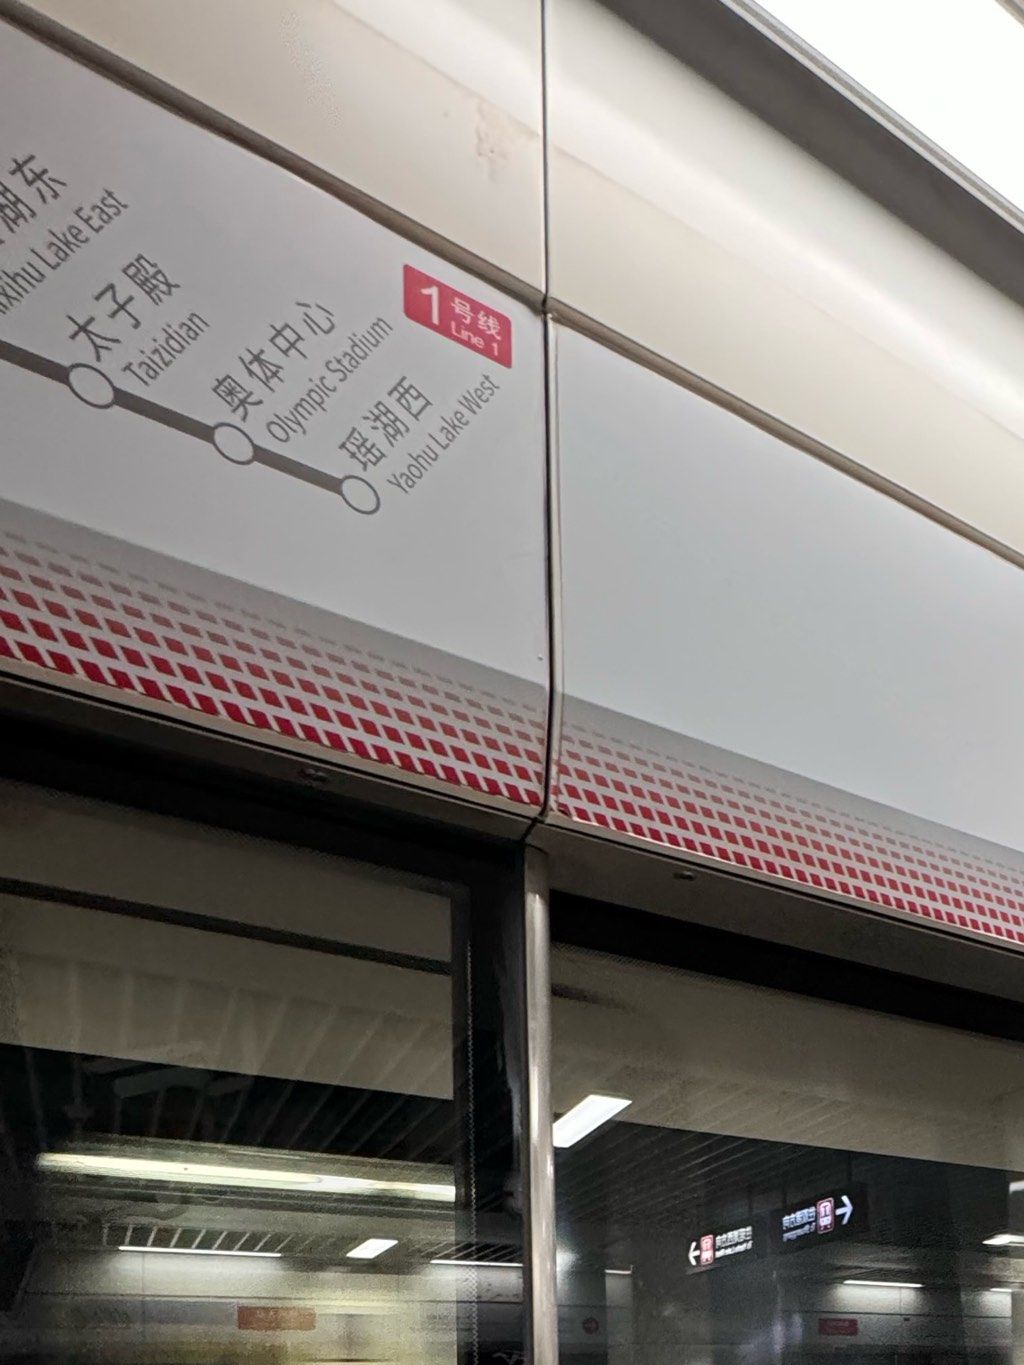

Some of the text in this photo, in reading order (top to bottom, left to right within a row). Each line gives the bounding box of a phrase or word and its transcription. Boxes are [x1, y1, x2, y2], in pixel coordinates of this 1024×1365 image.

[30, 224, 90, 270] Lake
[73, 188, 129, 233] East
[66, 253, 181, 362] 太子殿
[122, 312, 211, 387] Taizidian
[450, 321, 499, 356] Line 1
[212, 302, 335, 422] 奥体中心
[266, 316, 394, 443] Olympic Stadium
[338, 375, 433, 472] 瑶湖西
[388, 373, 501, 494] Yaohu Lake West
